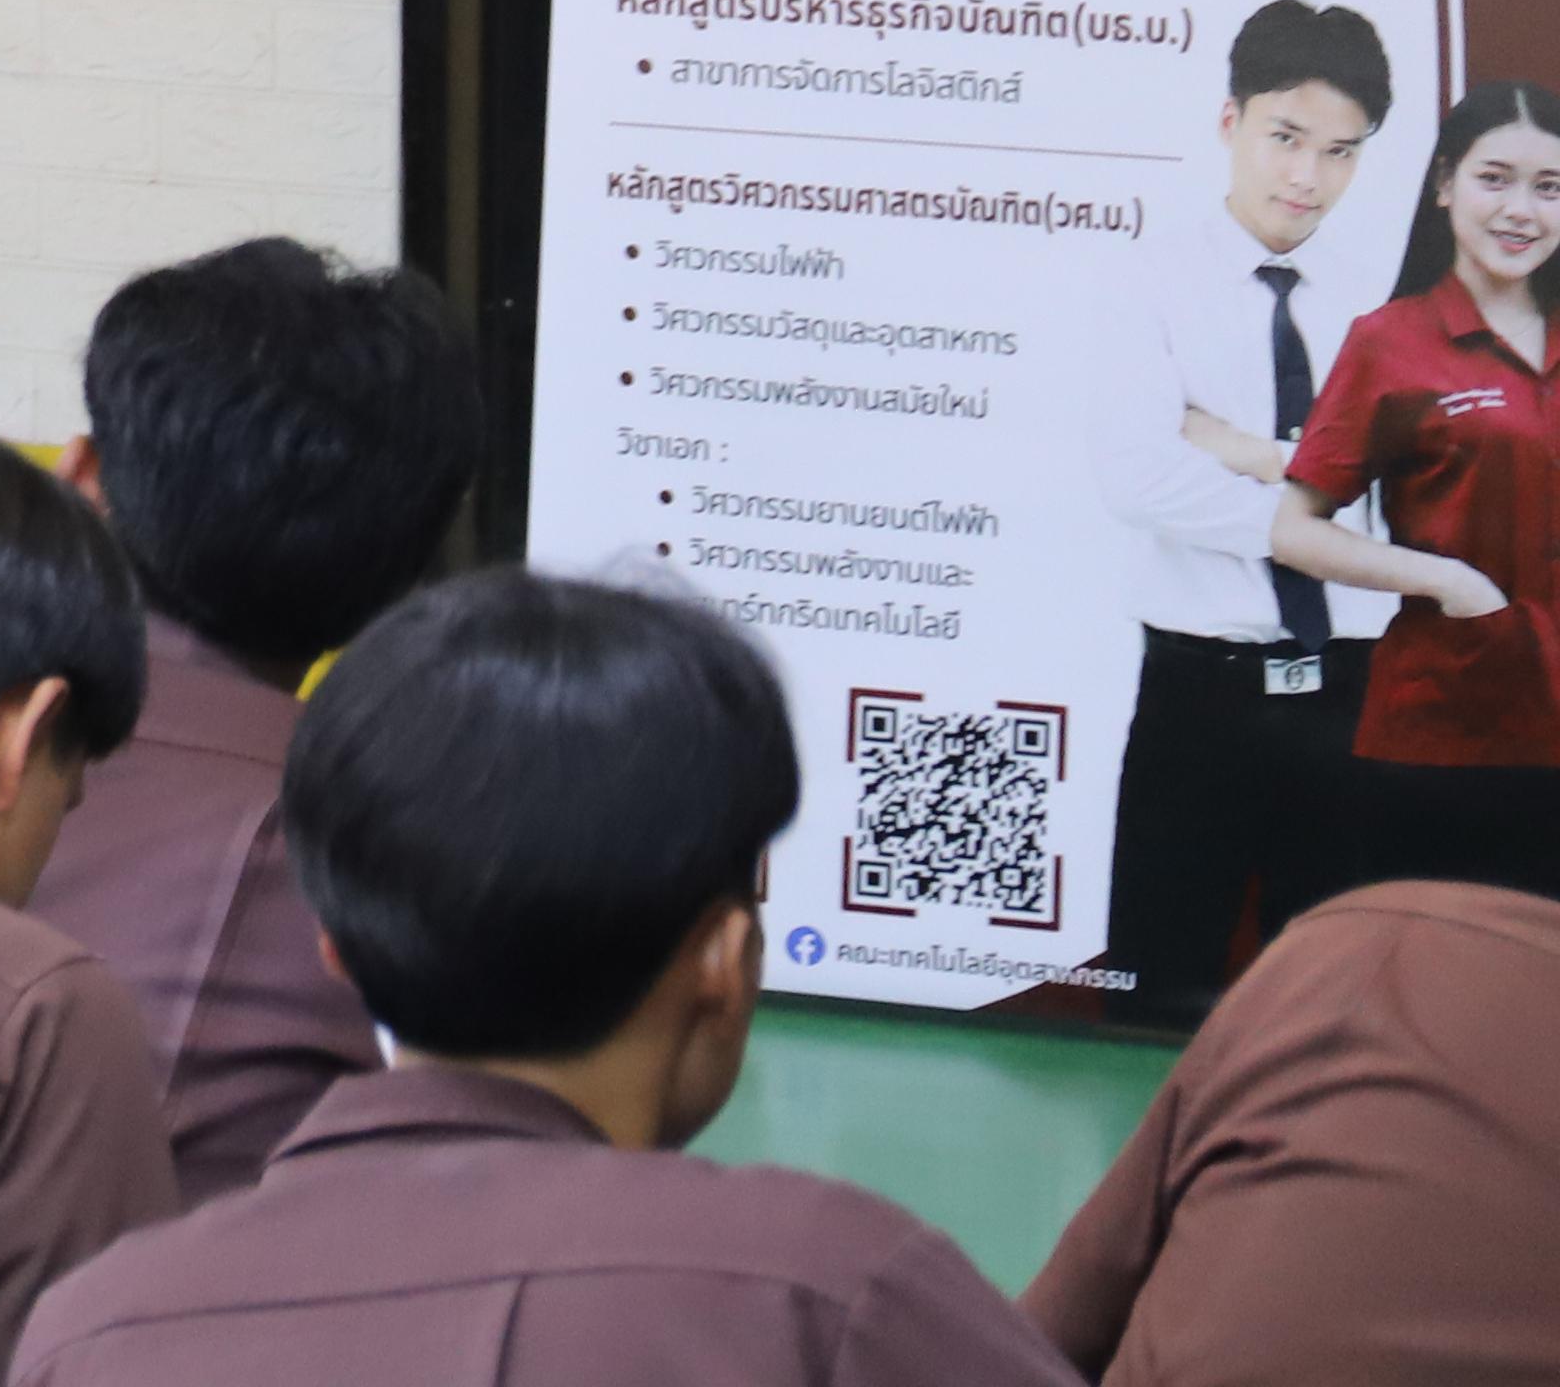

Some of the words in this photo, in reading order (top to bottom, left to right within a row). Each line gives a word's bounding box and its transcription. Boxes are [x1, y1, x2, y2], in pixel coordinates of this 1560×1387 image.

[671, 56, 1024, 105] สาขาการจัดการโลจิสติกส์
[606, 165, 1146, 240] หลักสูตรวิศวกรรมศาสตรบัณฑิต(วศ.บ.)
[654, 239, 846, 282] วิศวกรรมไฟฟ้า
[652, 301, 1019, 358] วิศวกรรมวัสดุและอุตสาหการ
[649, 365, 990, 421] วิศวกรรมพลังงานสมัยใหม่
[617, 426, 710, 462] วิชาเอก
[690, 484, 1000, 539] วิศวกรรมยานยนต์ไฟฟ้า
[687, 537, 975, 588] วิศวกรรมพลังงานและ
[835, 941, 1138, 992] คณะเทคโนโลยีอุตสาหกรรม
